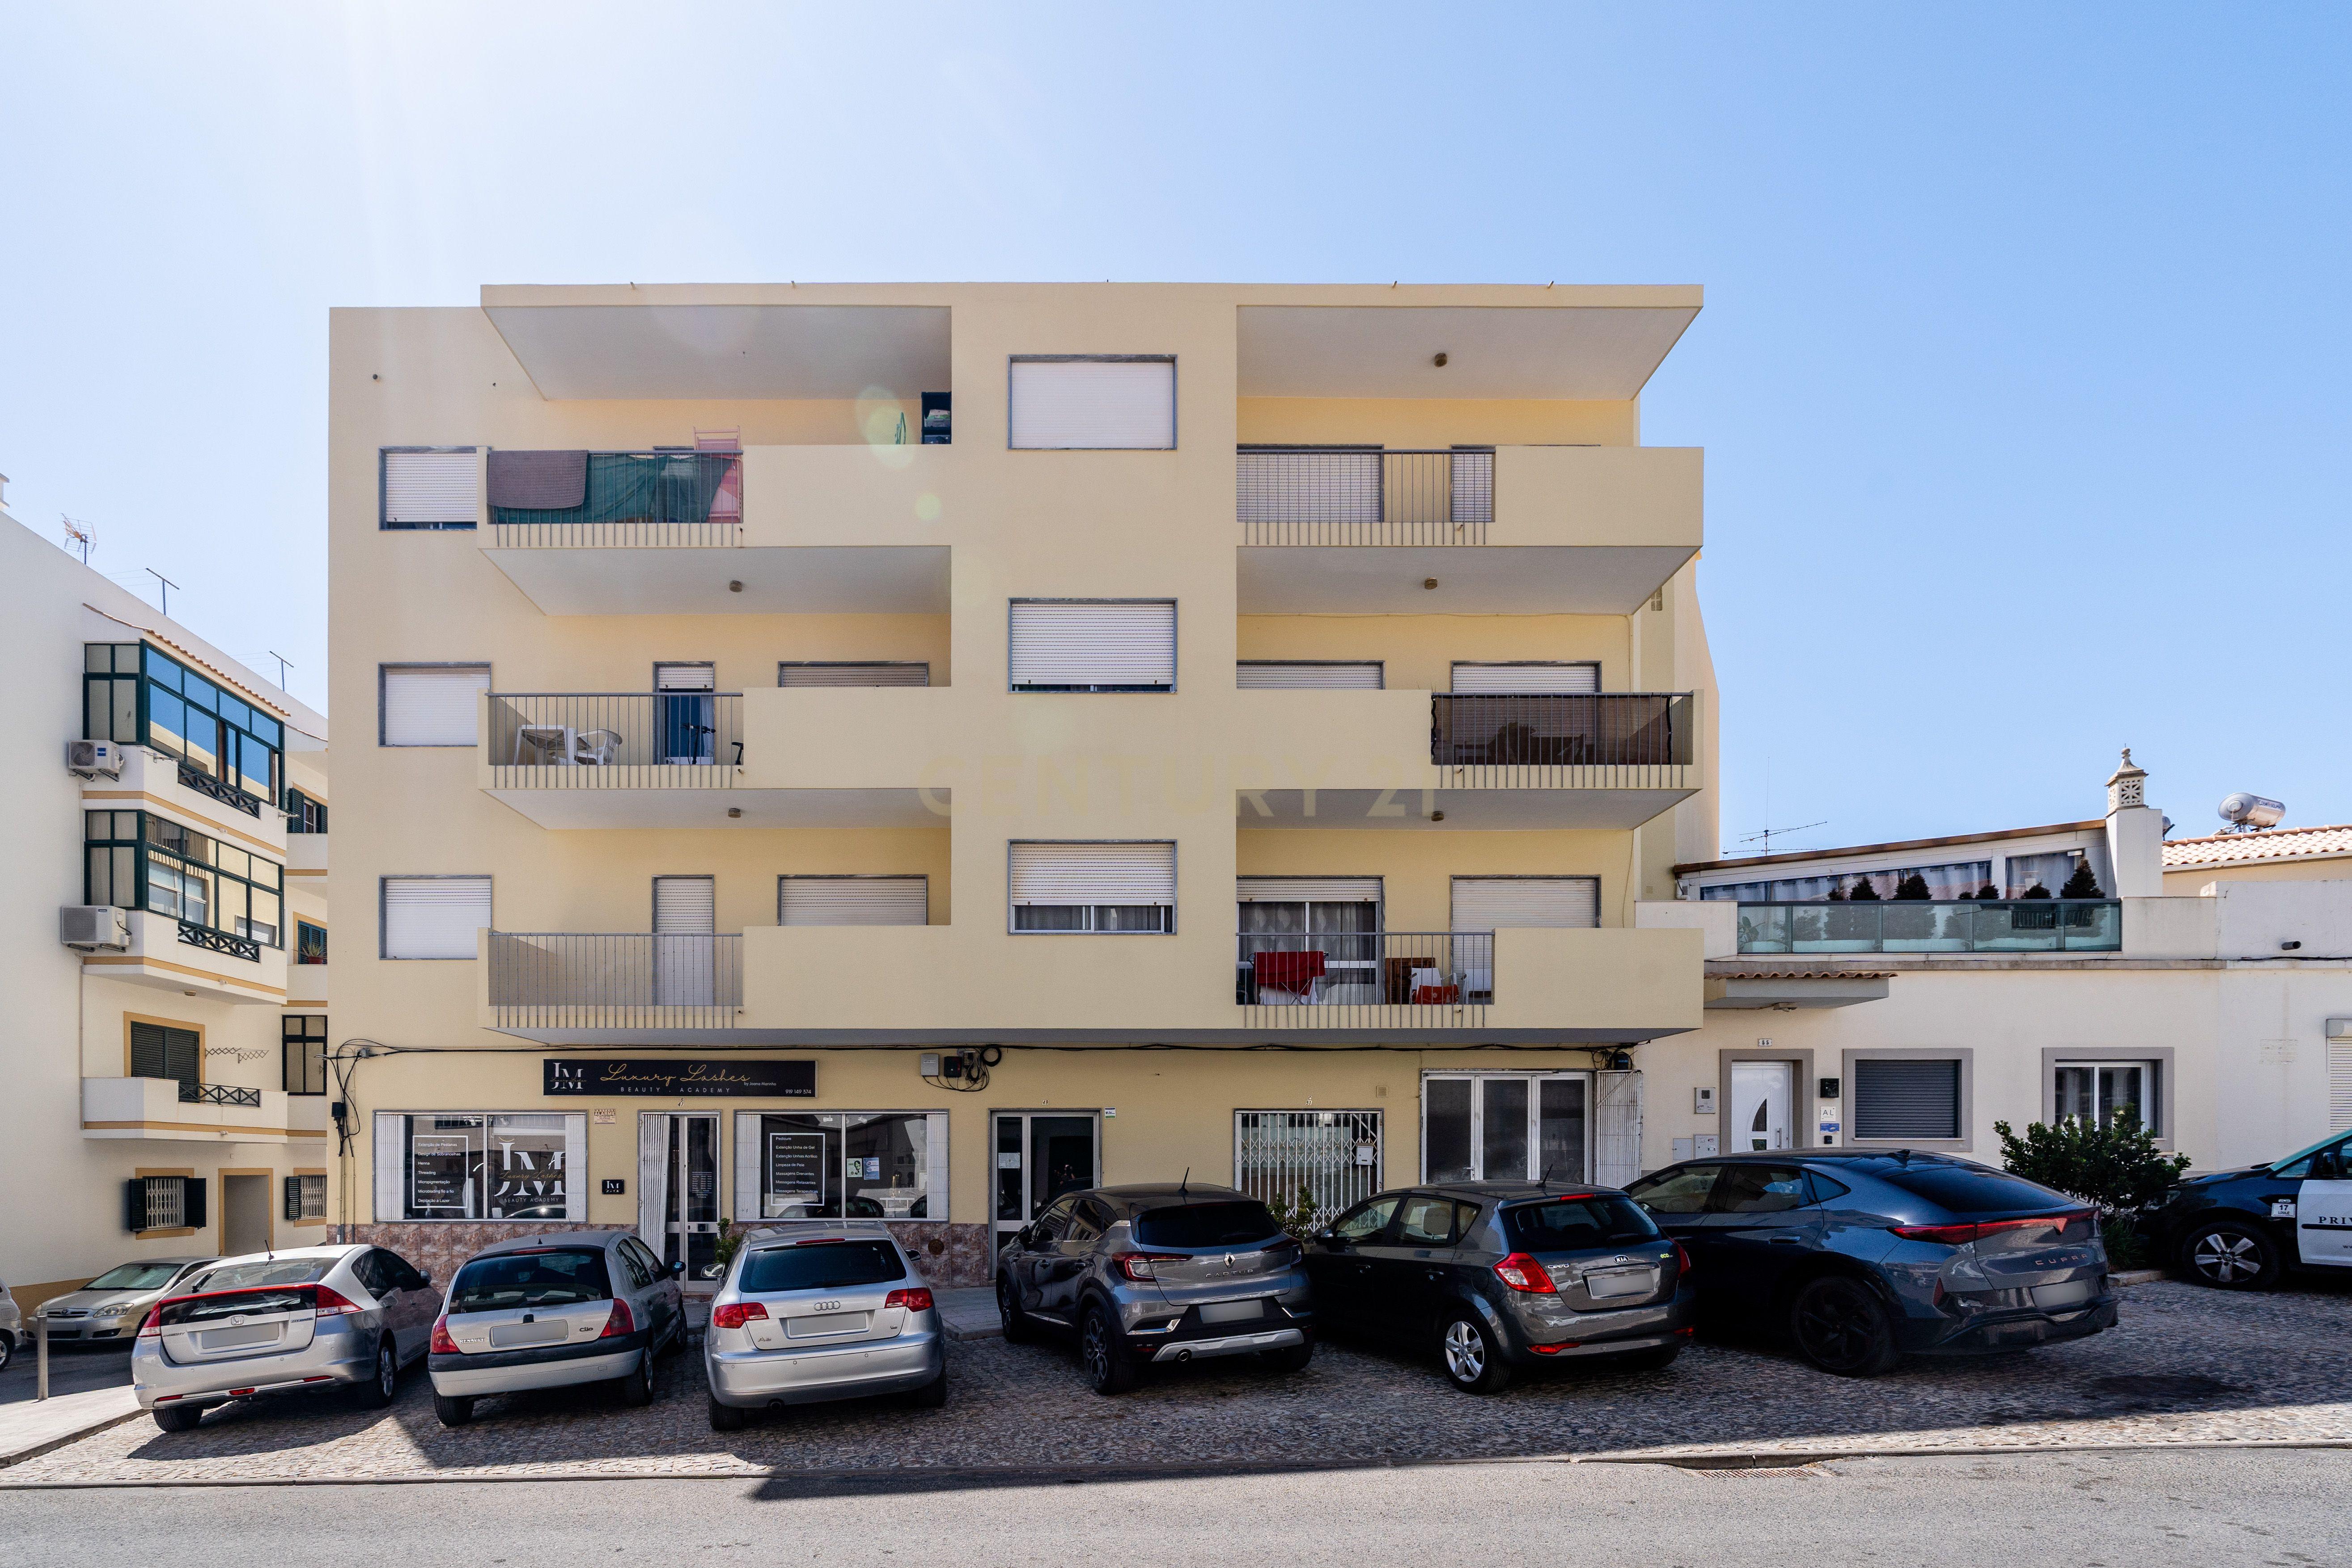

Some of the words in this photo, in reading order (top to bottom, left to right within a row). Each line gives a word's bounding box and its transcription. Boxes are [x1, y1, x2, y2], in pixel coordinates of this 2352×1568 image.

[600, 1064, 676, 1087] Luxury
[680, 1064, 750, 1081] Lashes
[499, 1170, 530, 1180] Luxury
[532, 1170, 564, 1179] Lashes
[2035, 1254, 2088, 1265] CUPRA
[1206, 1269, 1253, 1279] CAPTUR
